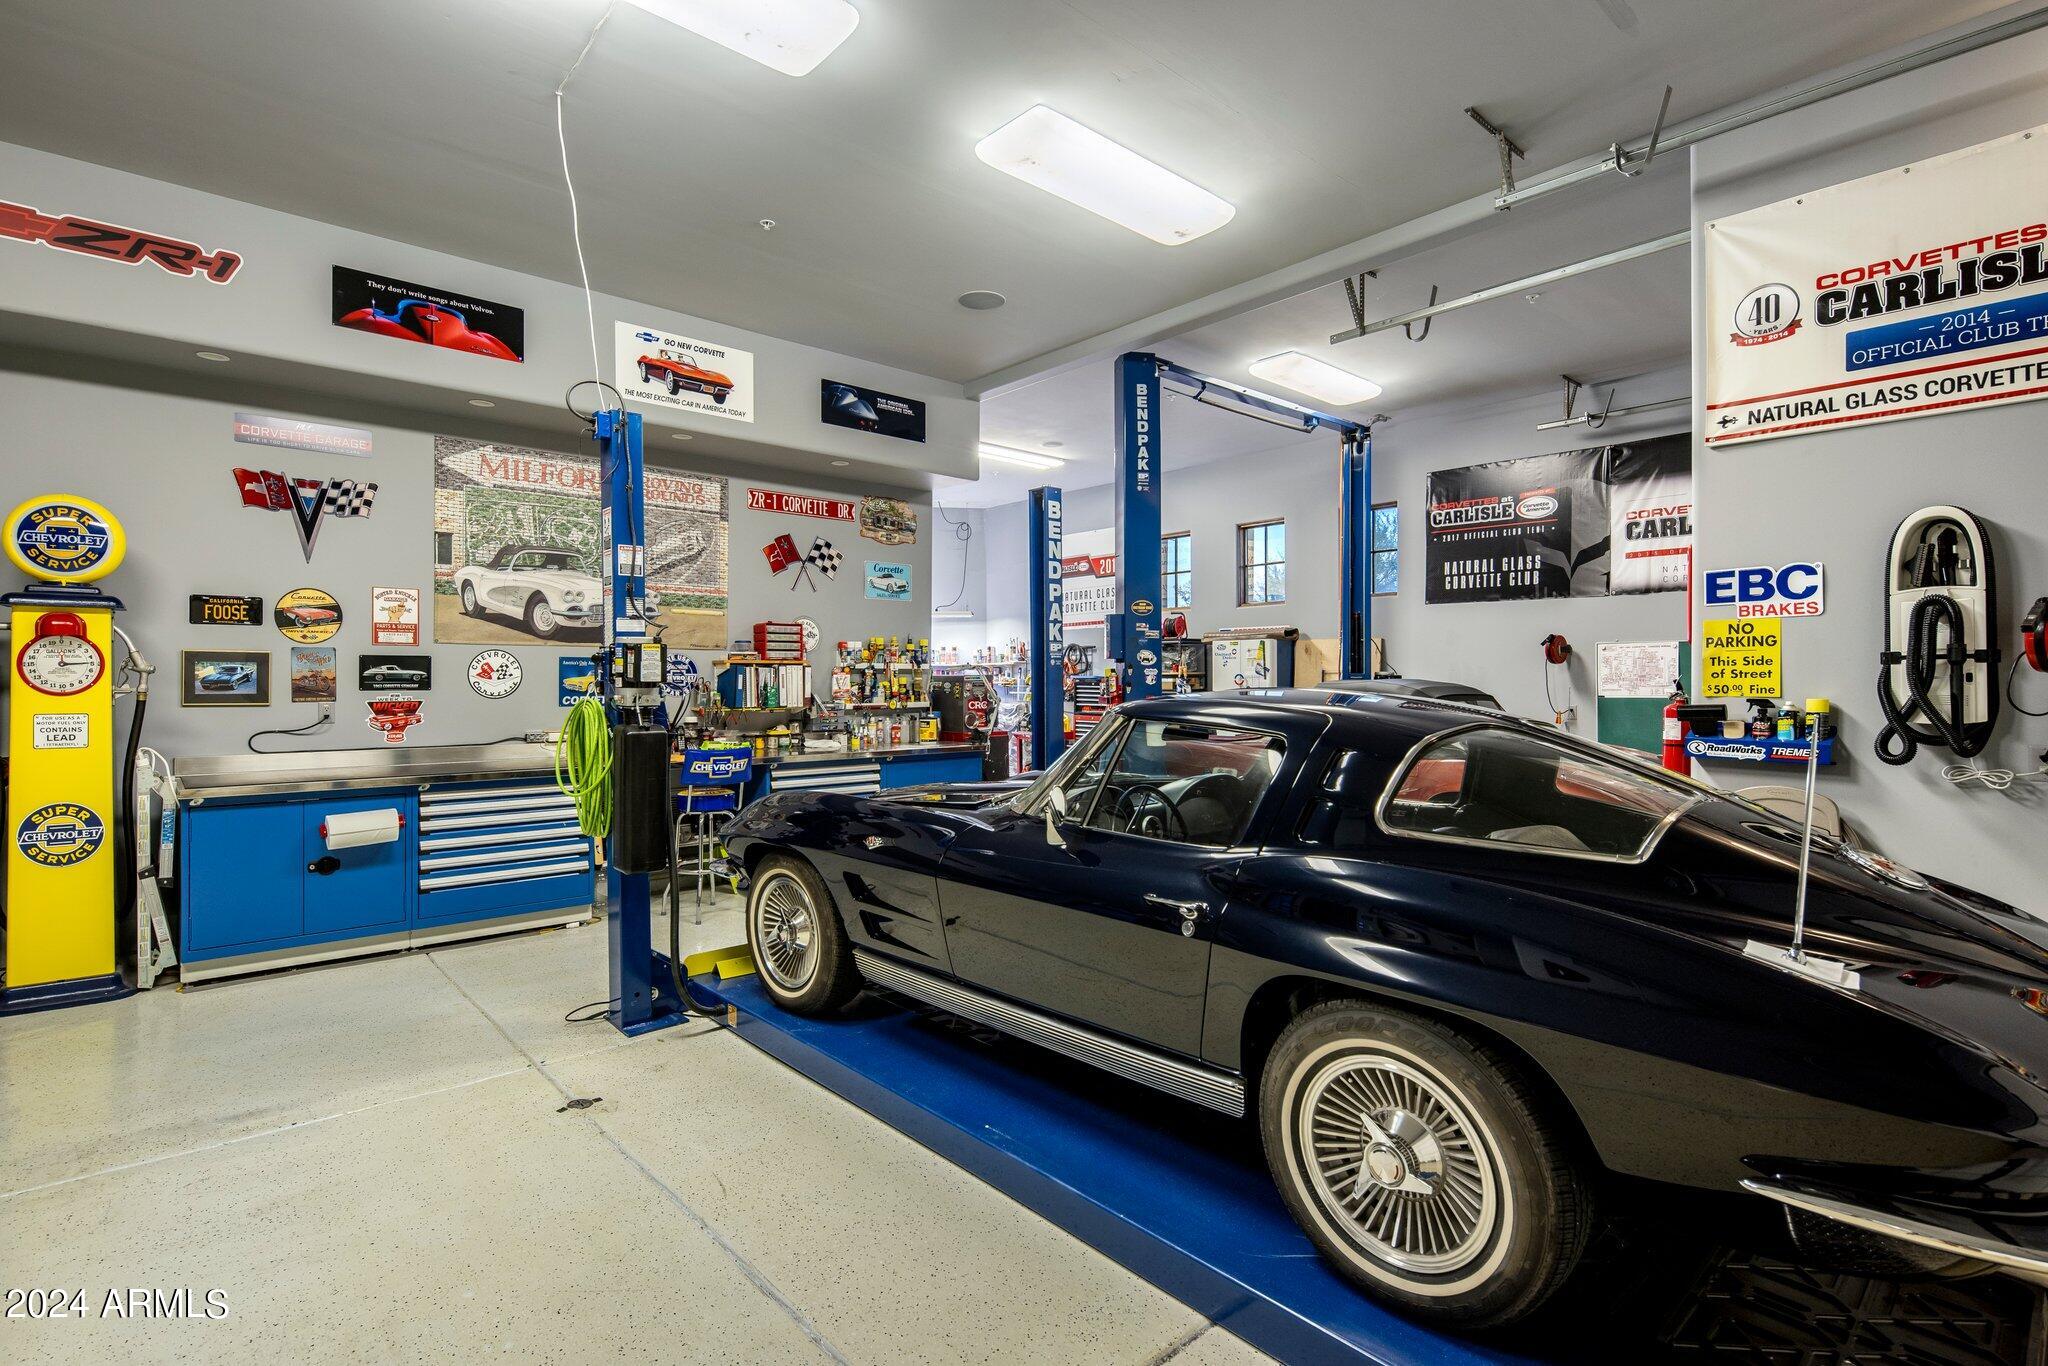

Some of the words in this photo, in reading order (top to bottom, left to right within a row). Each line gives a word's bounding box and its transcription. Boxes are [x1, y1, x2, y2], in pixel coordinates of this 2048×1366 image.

[53, 222, 236, 278] ZR-1
[1816, 223, 2048, 290] CORVETTES
[367, 280, 386, 291] They
[387, 285, 407, 295] don't
[408, 290, 427, 300] write
[428, 295, 448, 304] songs
[449, 299, 469, 309] about
[470, 303, 495, 315] Volvos.
[1748, 294, 1780, 326] 40
[1941, 309, 1991, 331] 2014
[1743, 337, 1763, 345] 1974
[1768, 331, 1788, 340] 2014
[1753, 324, 1779, 335] YEARS
[677, 341, 692, 351] NEW
[693, 345, 725, 358] CORVETTE
[1852, 334, 1952, 364] OFFICIAL
[1958, 321, 2020, 345] CLUB
[1747, 397, 1841, 426] NATURAL
[1846, 383, 1919, 410] GLASS
[1924, 361, 2048, 397] CORVETTE
[624, 388, 635, 397] THE
[636, 391, 653, 401] MOST
[654, 395, 681, 406] EXCITING
[682, 400, 694, 408] CAR
[702, 404, 727, 415] AMERICA
[728, 410, 746, 418] TODAY
[1136, 383, 1150, 471] BENDPAK
[240, 424, 311, 442] CORVETTE
[315, 434, 367, 449] GARAGE
[752, 492, 777, 509] ZR-1
[782, 496, 829, 515] CORVETTE
[837, 503, 853, 519] DR.
[1432, 497, 1499, 510] CORVETTES
[31, 507, 94, 526] SUPER
[1432, 503, 1514, 527] CARLISLE
[23, 532, 103, 546] CHEVROLET
[1442, 534, 1460, 542] 2017
[1464, 529, 1499, 540] OFFICIAL
[27, 547, 99, 570] SERVICE
[1444, 558, 1495, 575] NATURAL
[1502, 555, 1541, 571] GLASS
[873, 563, 904, 575] Corvette
[1048, 500, 1062, 641] BENDPAK
[1445, 573, 1501, 589] CORVETTE
[1509, 570, 1539, 586] CLUB
[1706, 564, 1818, 605] EBC
[204, 604, 249, 620] FOOSE
[1739, 602, 1819, 618] BRAKES
[1728, 623, 1754, 635] NO
[1706, 635, 1777, 648] PARKING
[471, 651, 519, 670] CHEVROLET
[1710, 657, 1737, 666] This
[1743, 655, 1773, 666] Side
[1711, 669, 1725, 679] of
[1730, 669, 1772, 679] Street
[1707, 684, 1743, 695] $50.00
[1749, 684, 1775, 694] Fine
[373, 702, 420, 710] WICKED
[968, 701, 988, 709] CRC
[1706, 743, 1763, 754] RoadWorks
[695, 762, 744, 771] CHEVROLET
[31, 806, 91, 824] SUPER
[25, 829, 98, 842] CHEVROLET
[28, 843, 95, 864] SERVICE
